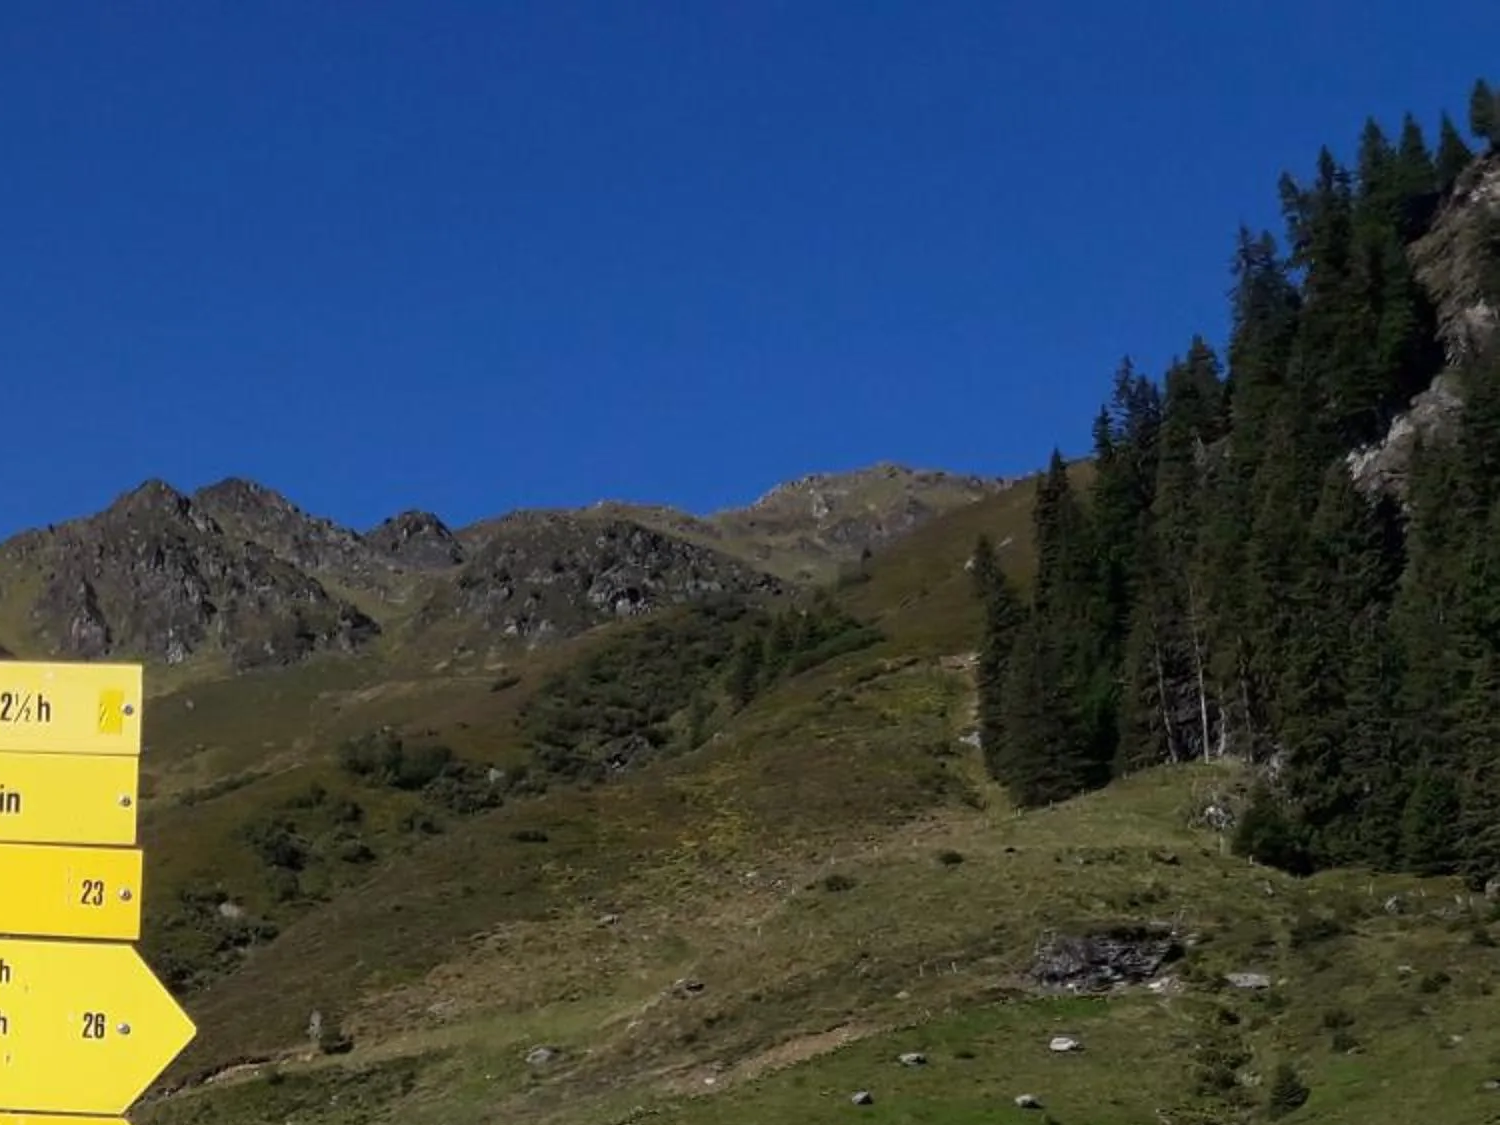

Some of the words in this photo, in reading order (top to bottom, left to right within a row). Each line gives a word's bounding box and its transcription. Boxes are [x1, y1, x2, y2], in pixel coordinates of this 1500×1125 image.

[37, 694, 51, 722] h
[81, 880, 104, 906] 23
[0, 959, 10, 983] h
[83, 1012, 105, 1038] 26
